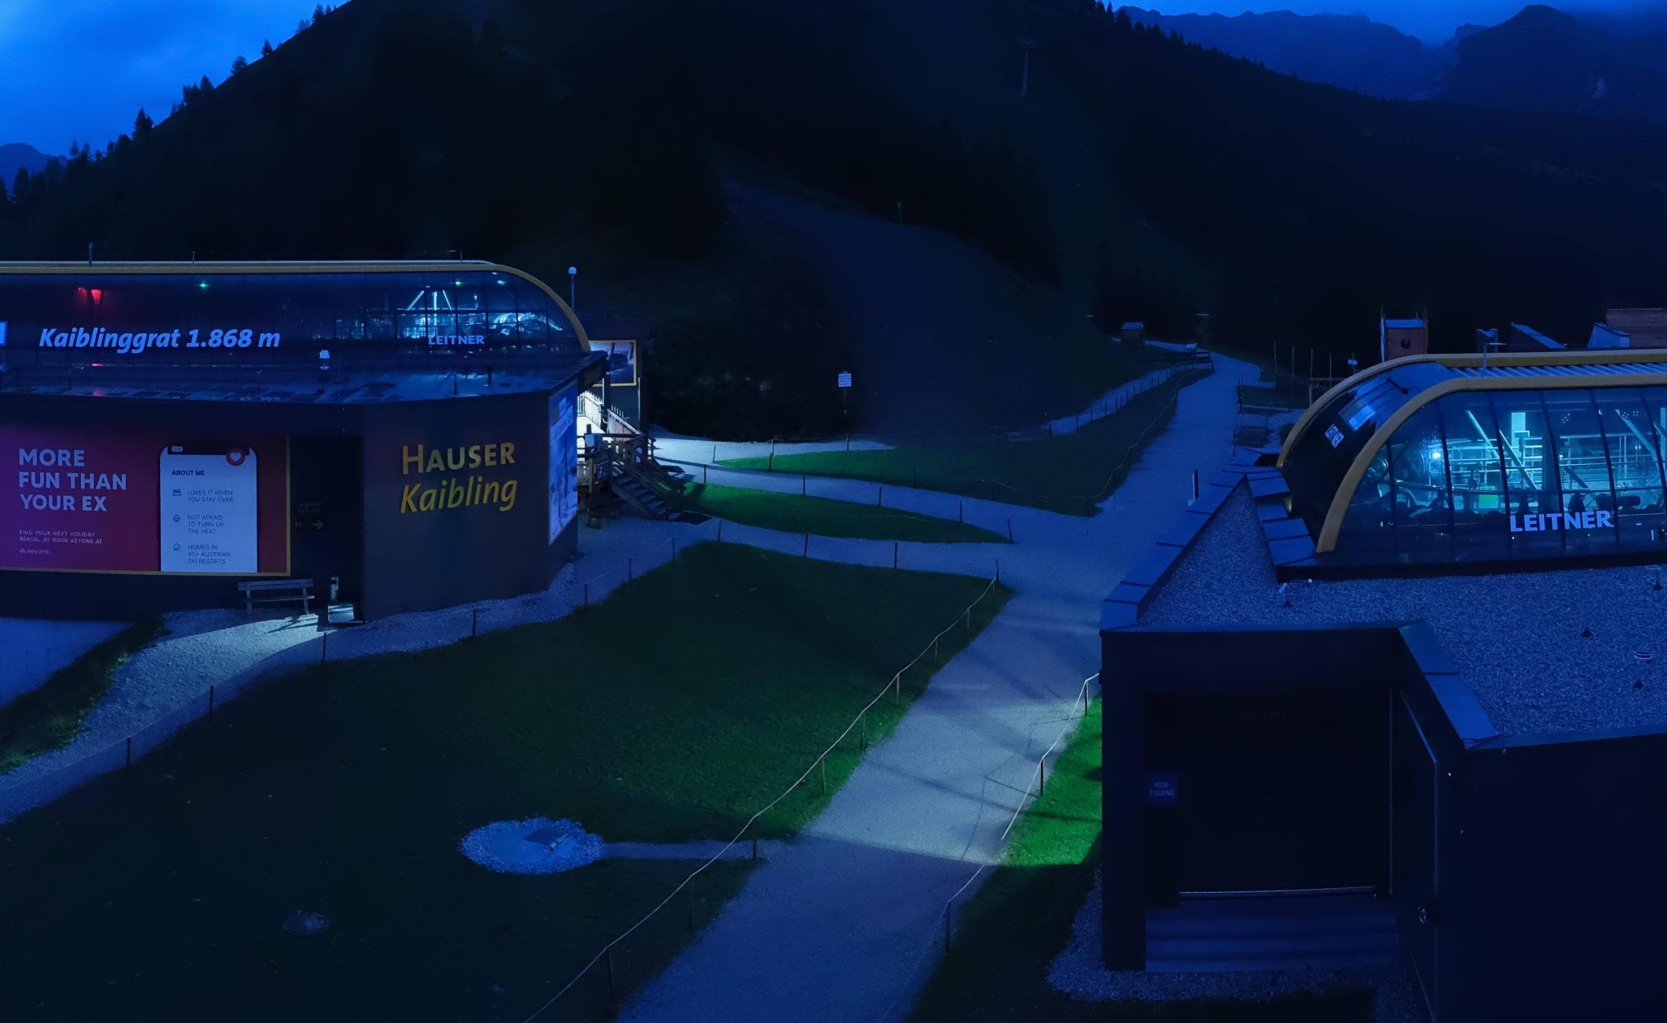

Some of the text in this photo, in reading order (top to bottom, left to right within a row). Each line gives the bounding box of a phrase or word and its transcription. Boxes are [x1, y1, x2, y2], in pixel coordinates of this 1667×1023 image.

[39, 327, 280, 354] Kaiblinggrat 1.868 m
[428, 335, 485, 346] LEITNER
[19, 448, 85, 467] MORE
[402, 442, 516, 475] HAUSER
[19, 471, 127, 490] FUN THAN
[20, 494, 107, 512] YOUR EX
[400, 476, 517, 514] Kaibling
[1510, 510, 1615, 533] LEITNER
